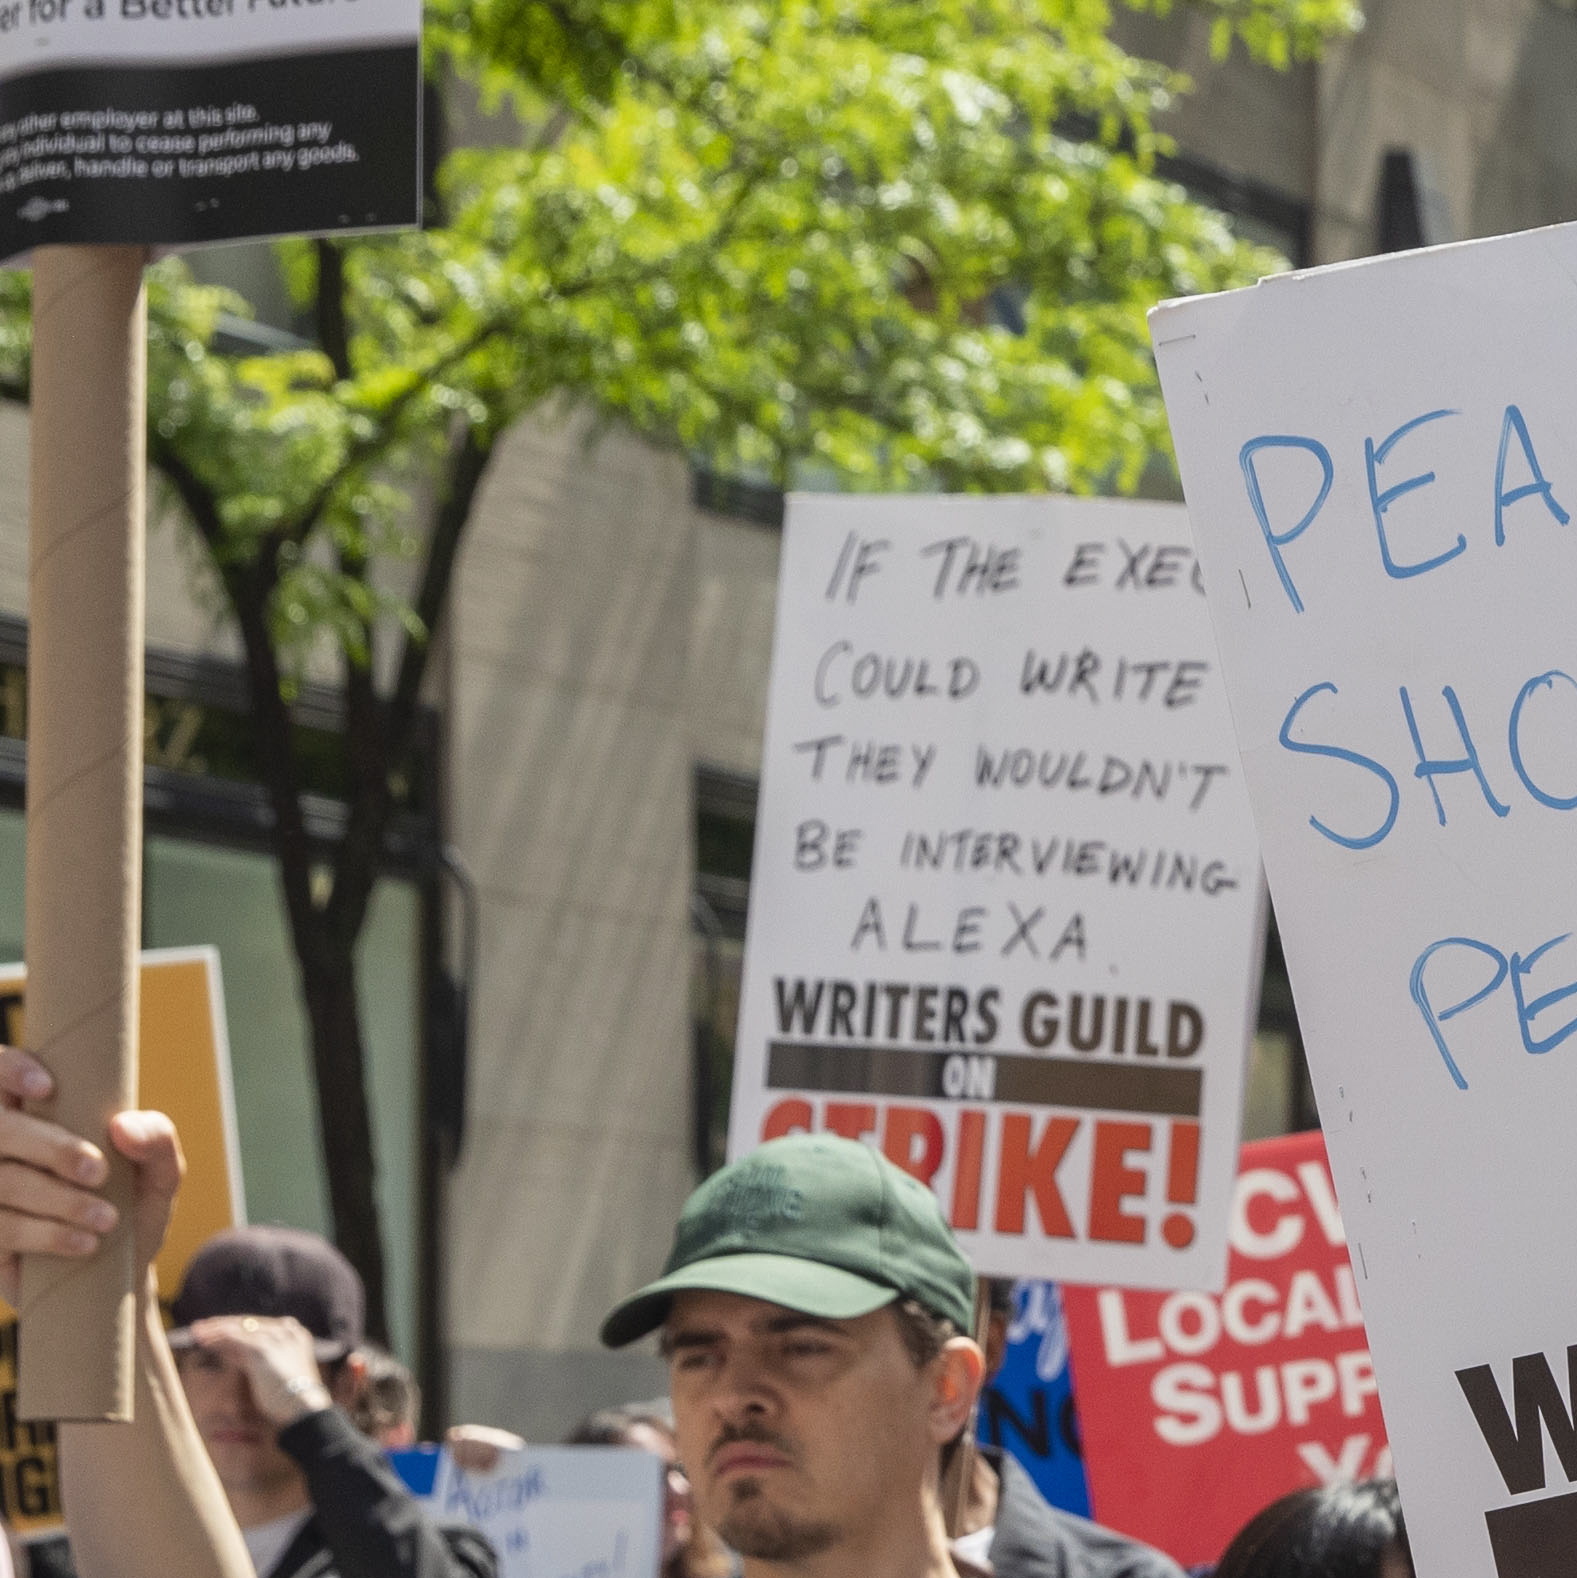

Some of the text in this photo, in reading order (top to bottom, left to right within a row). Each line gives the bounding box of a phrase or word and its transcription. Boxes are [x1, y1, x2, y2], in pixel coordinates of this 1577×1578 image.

[60, 106, 158, 133] employer
[163, 109, 185, 129] at
[187, 105, 223, 128] this
[108, 134, 133, 153] to
[135, 134, 196, 154] cease
[297, 119, 334, 144] any
[73, 155, 149, 178] handle
[150, 159, 175, 178] or
[178, 151, 261, 179] transport
[262, 150, 296, 172] any
[823, 527, 892, 604] IF
[920, 534, 1023, 600] THE
[813, 638, 1210, 710] COULD WRITE
[792, 734, 1229, 811] THEY WOULDN'T
[792, 817, 1240, 897] BE INTERVIEWING
[774, 975, 1206, 1060] WRITERS GUILD
[942, 1053, 997, 1101] ON
